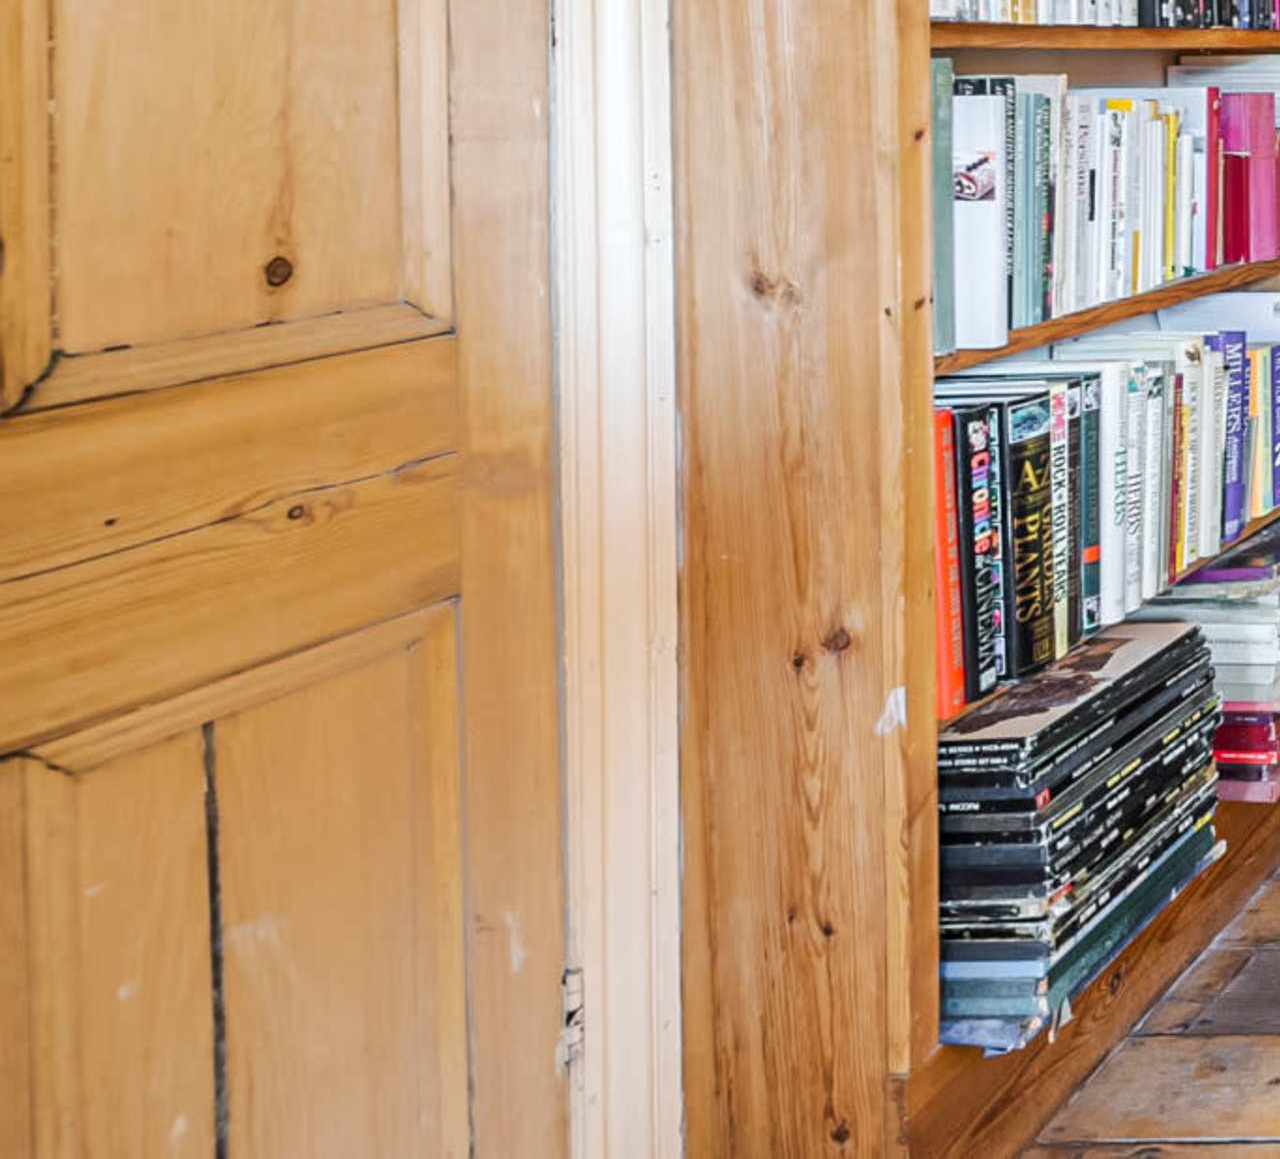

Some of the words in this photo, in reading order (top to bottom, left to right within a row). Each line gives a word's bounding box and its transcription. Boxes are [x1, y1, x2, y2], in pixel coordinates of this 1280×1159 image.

[1226, 341, 1244, 434] MILLER'S
[969, 452, 992, 556] Chronicle
[1051, 443, 1068, 492] ROCK
[1113, 445, 1129, 528] HERBS
[1052, 502, 1069, 546] ROLL
[1013, 514, 1044, 624] PLANTS
[1053, 548, 1071, 604] YEARS
[975, 568, 998, 672] CINEMA
